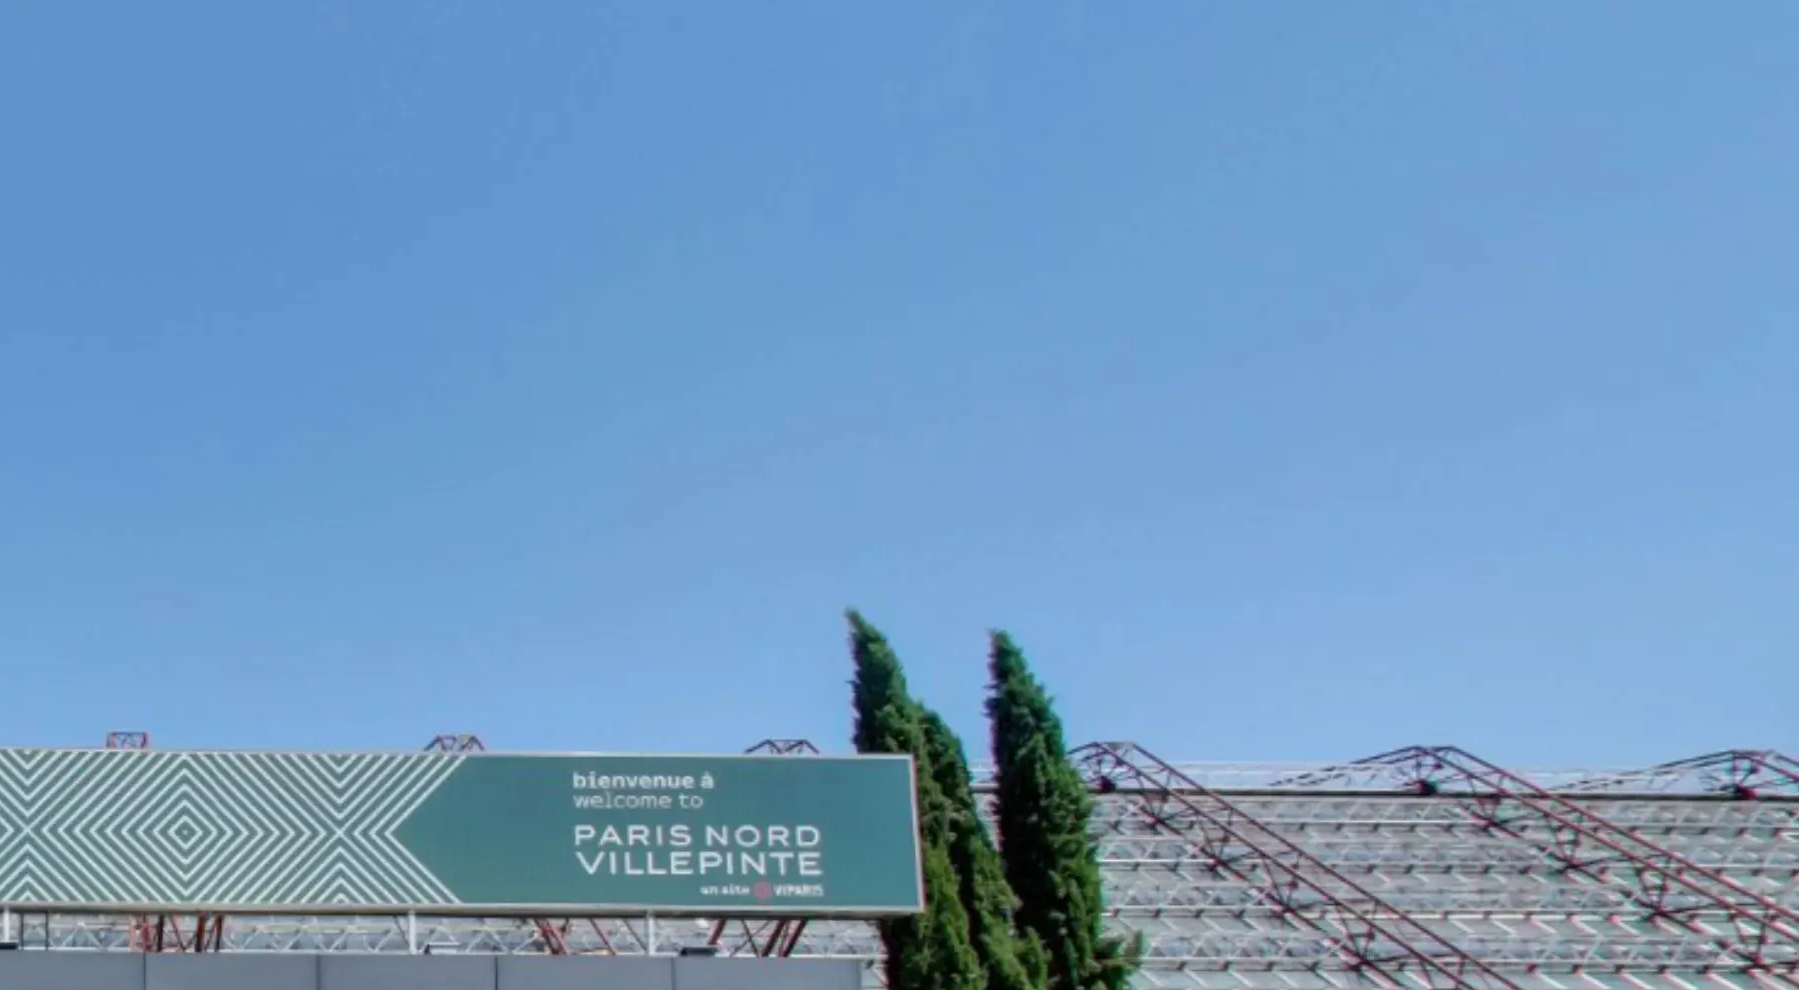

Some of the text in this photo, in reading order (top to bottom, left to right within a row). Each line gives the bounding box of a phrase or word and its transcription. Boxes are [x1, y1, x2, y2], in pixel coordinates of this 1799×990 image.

[572, 771, 715, 790] bienvenue à
[573, 792, 704, 809] welcome to
[574, 825, 822, 848] PARIS NORD
[575, 851, 824, 876] VILLEPINTE
